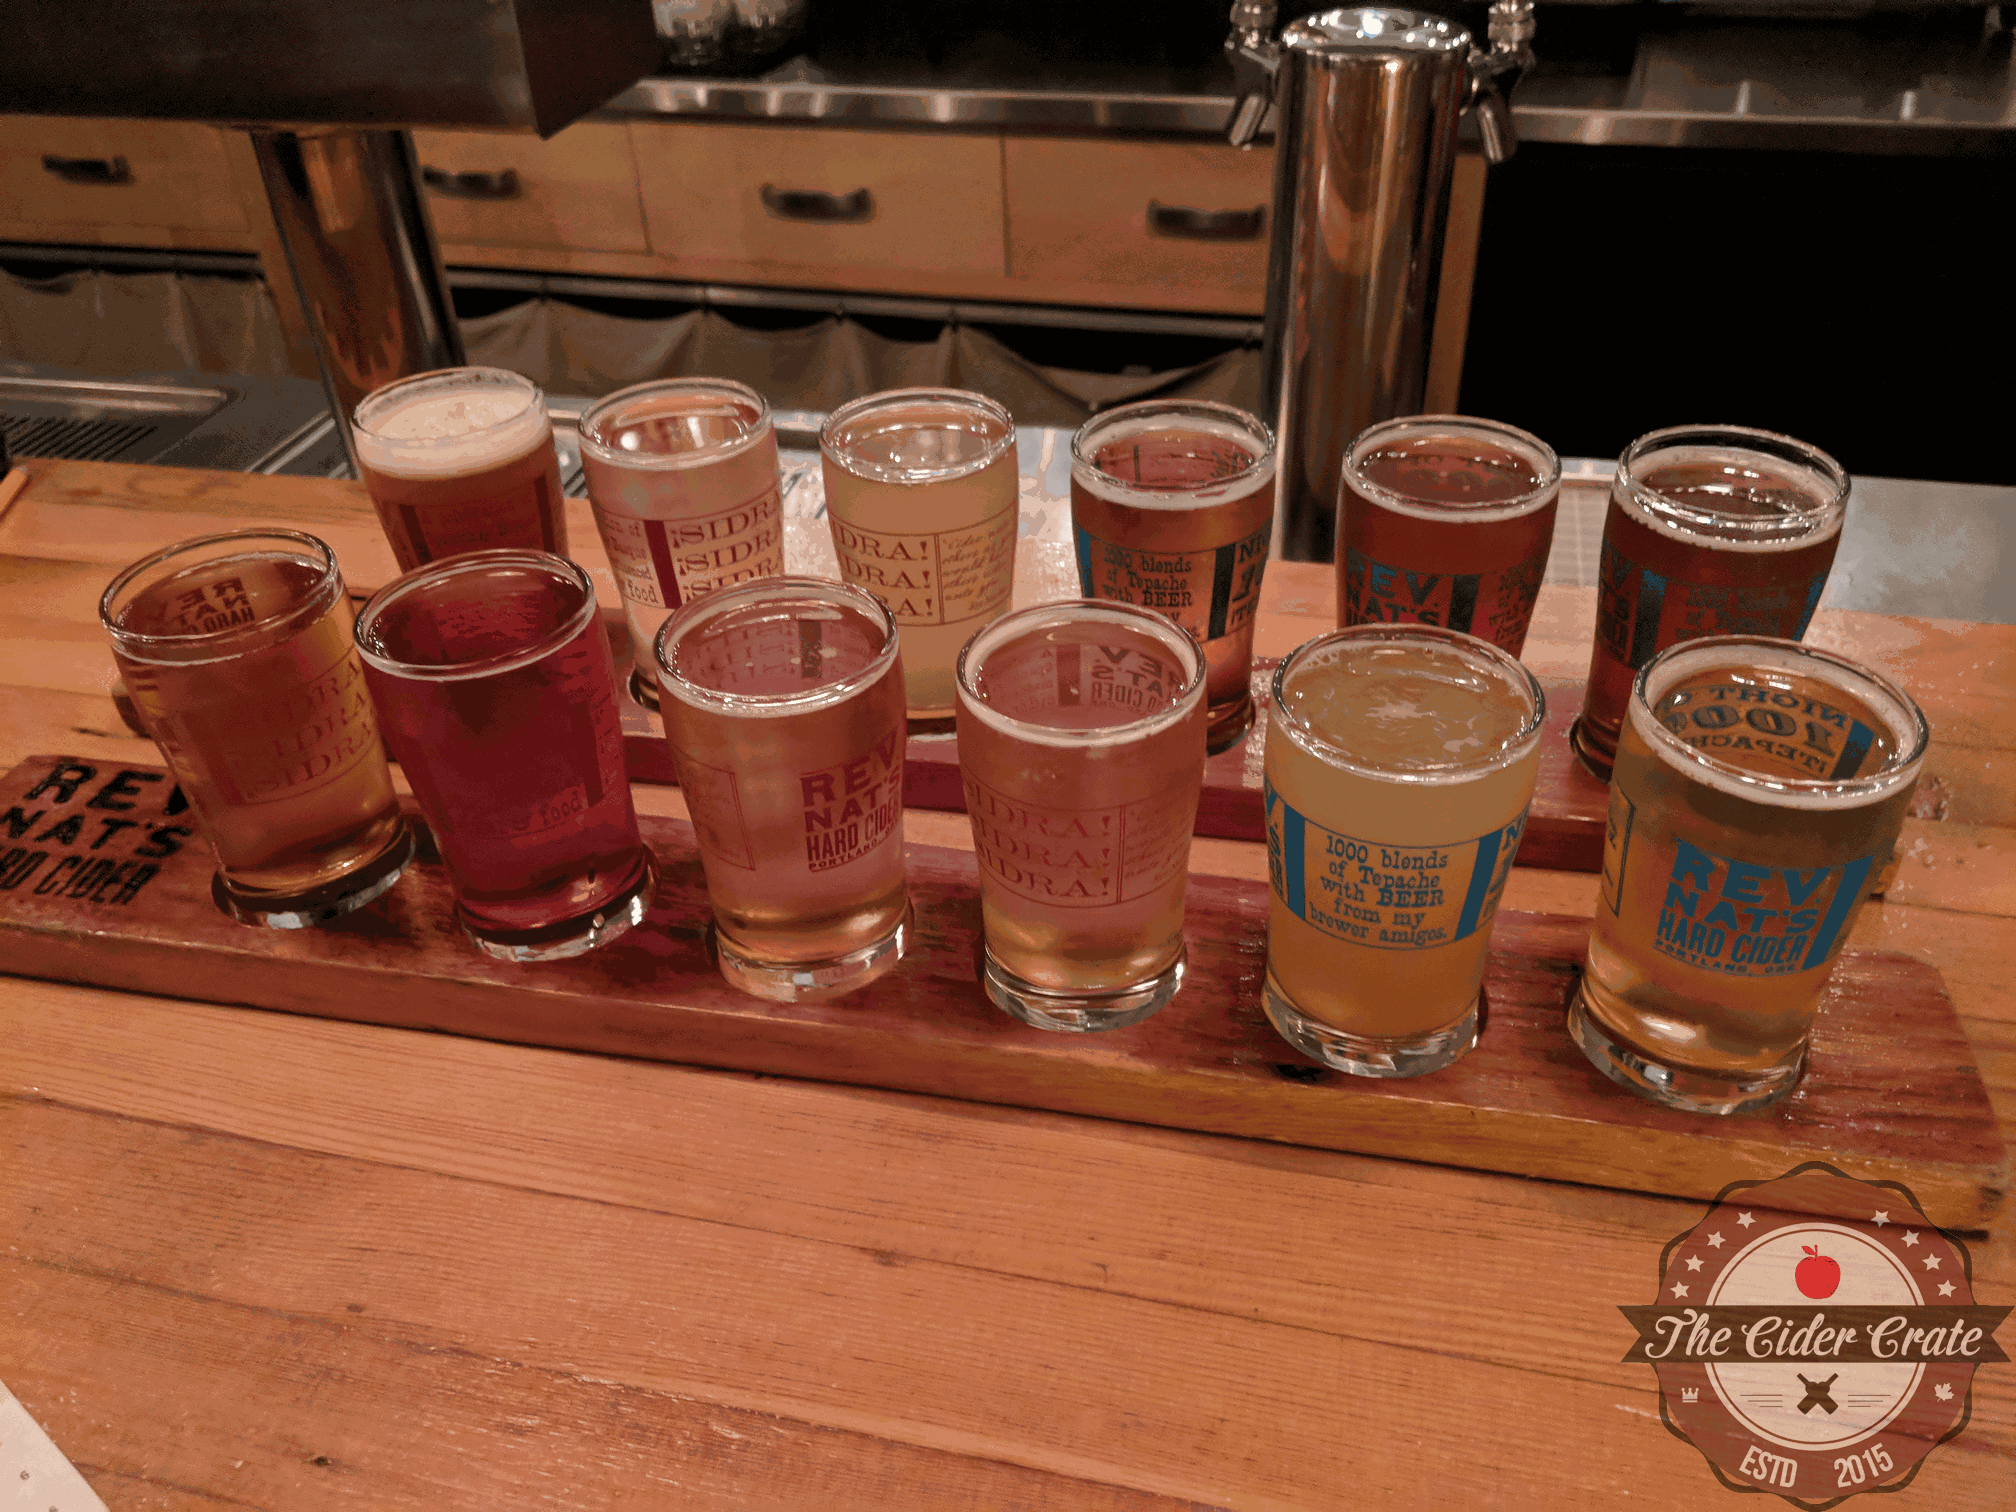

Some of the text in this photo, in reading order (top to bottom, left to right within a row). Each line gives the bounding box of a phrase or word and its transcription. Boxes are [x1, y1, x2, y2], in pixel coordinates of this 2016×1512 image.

[1126, 571, 1187, 591] Tepache
[1141, 554, 1192, 574] blends
[627, 580, 659, 604] food
[1142, 590, 1193, 608] BEER
[541, 789, 583, 825] food
[804, 765, 900, 832] NAT'S
[0, 806, 193, 858] NAT'S
[806, 823, 859, 862] HARD
[1326, 835, 1448, 871] 1000 blends
[34, 855, 160, 905] CIDER
[1329, 860, 1440, 890] of Tepache
[1671, 836, 1823, 907] REV.
[1320, 875, 1445, 908] with BEER
[1663, 881, 1820, 934] NAT'S
[1309, 901, 1447, 948] brewer amigos.
[1334, 897, 1426, 930] from my
[1656, 907, 1808, 965] HARD CIDER
